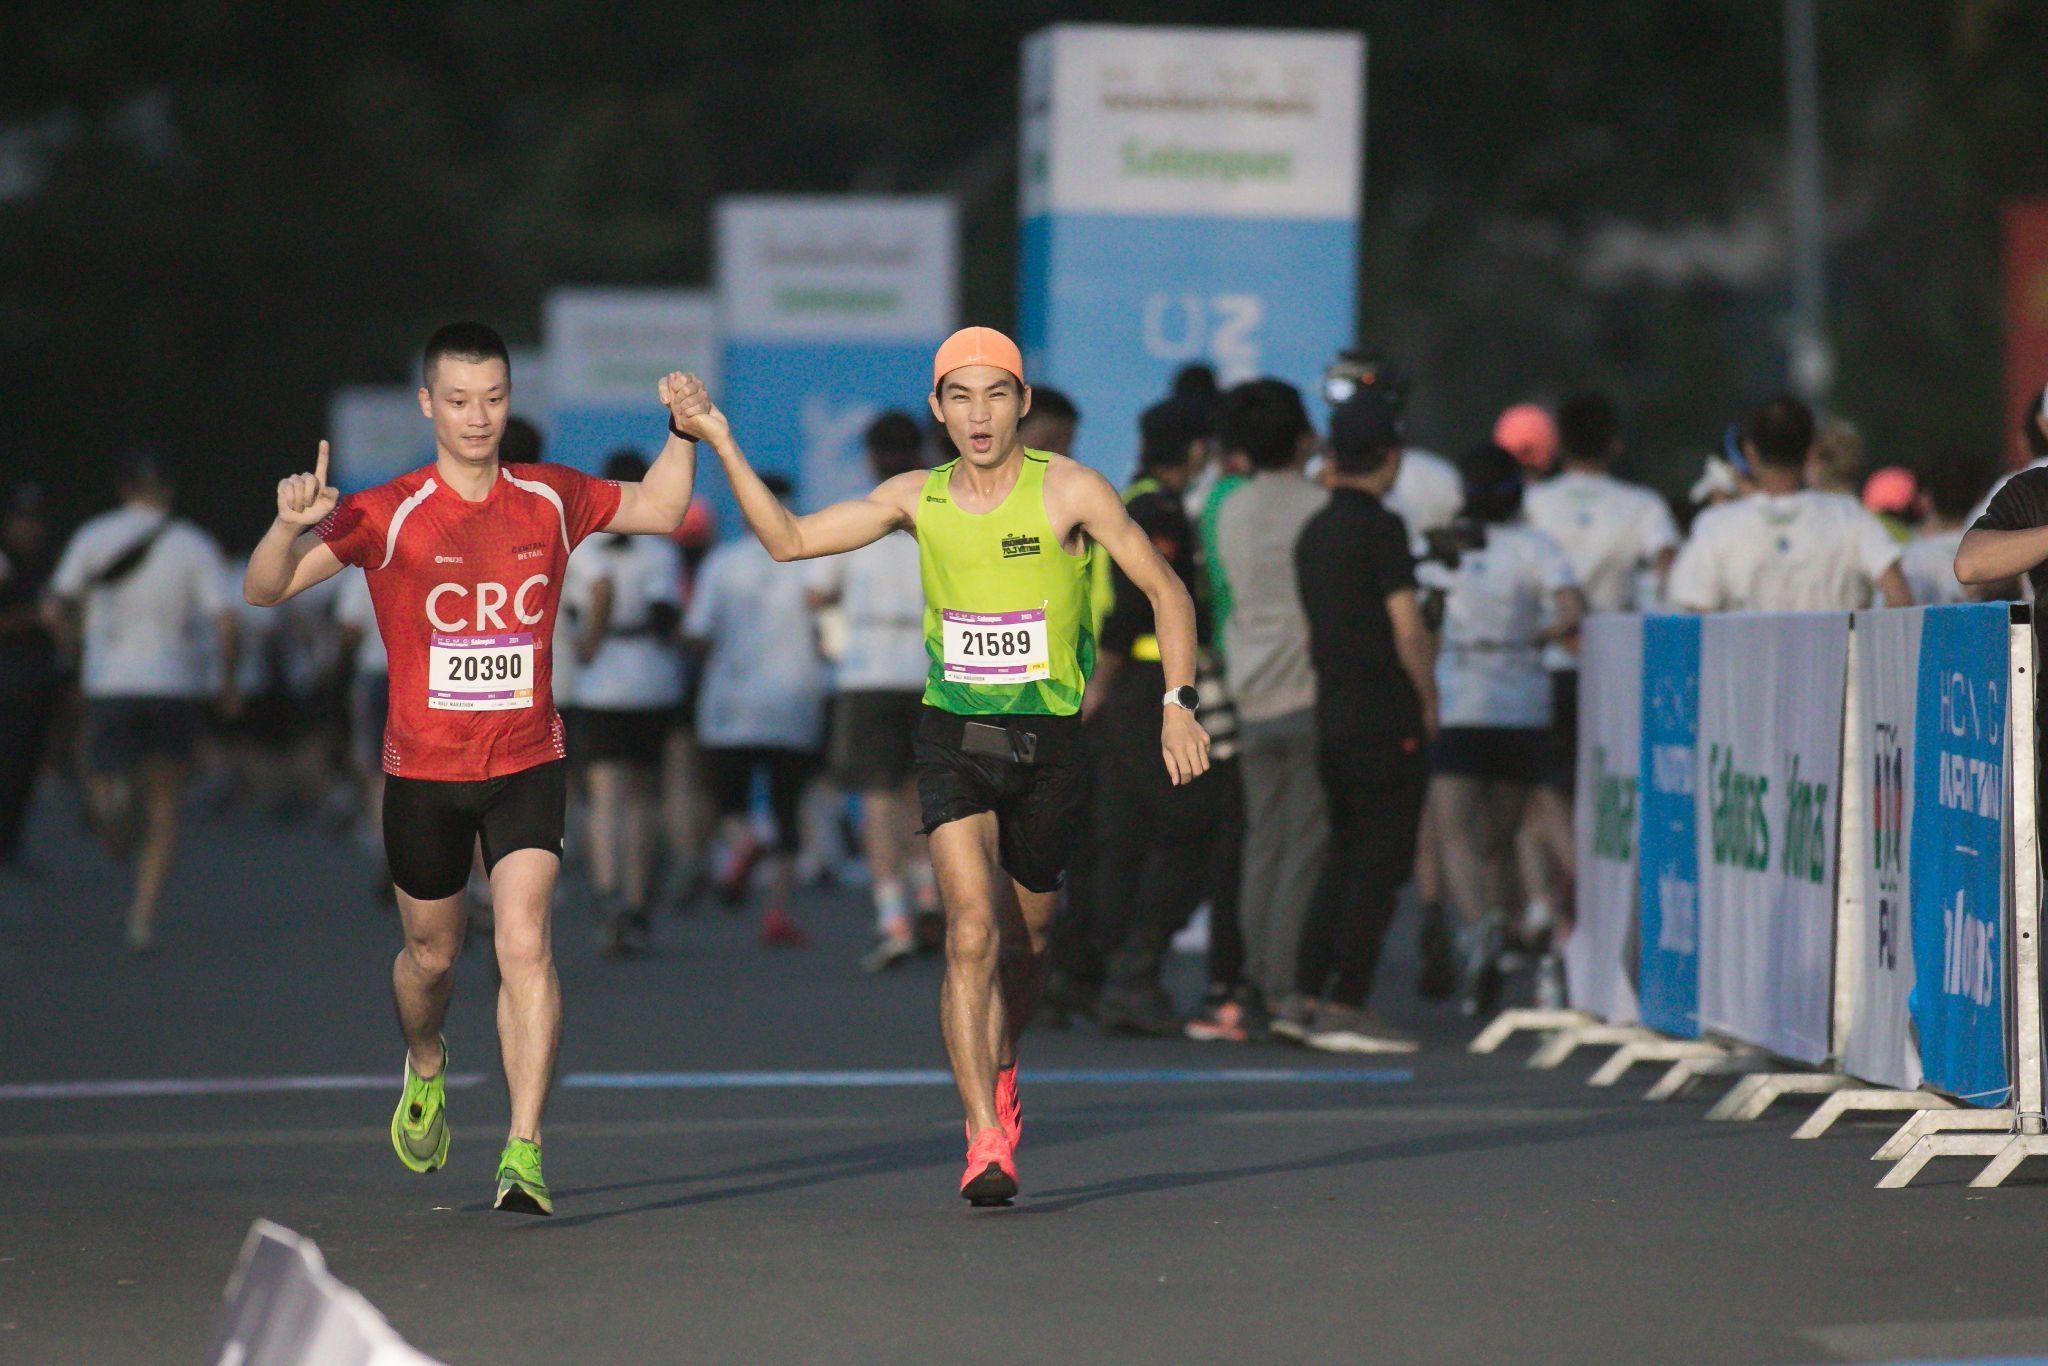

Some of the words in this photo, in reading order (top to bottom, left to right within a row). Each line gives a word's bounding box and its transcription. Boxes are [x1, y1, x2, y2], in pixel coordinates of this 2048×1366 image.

[512, 542, 545, 553] CENTRAL
[518, 549, 544, 560] RETAIL
[425, 573, 549, 631] CRC
[962, 630, 1030, 656] 21589
[449, 653, 522, 681] 20390
